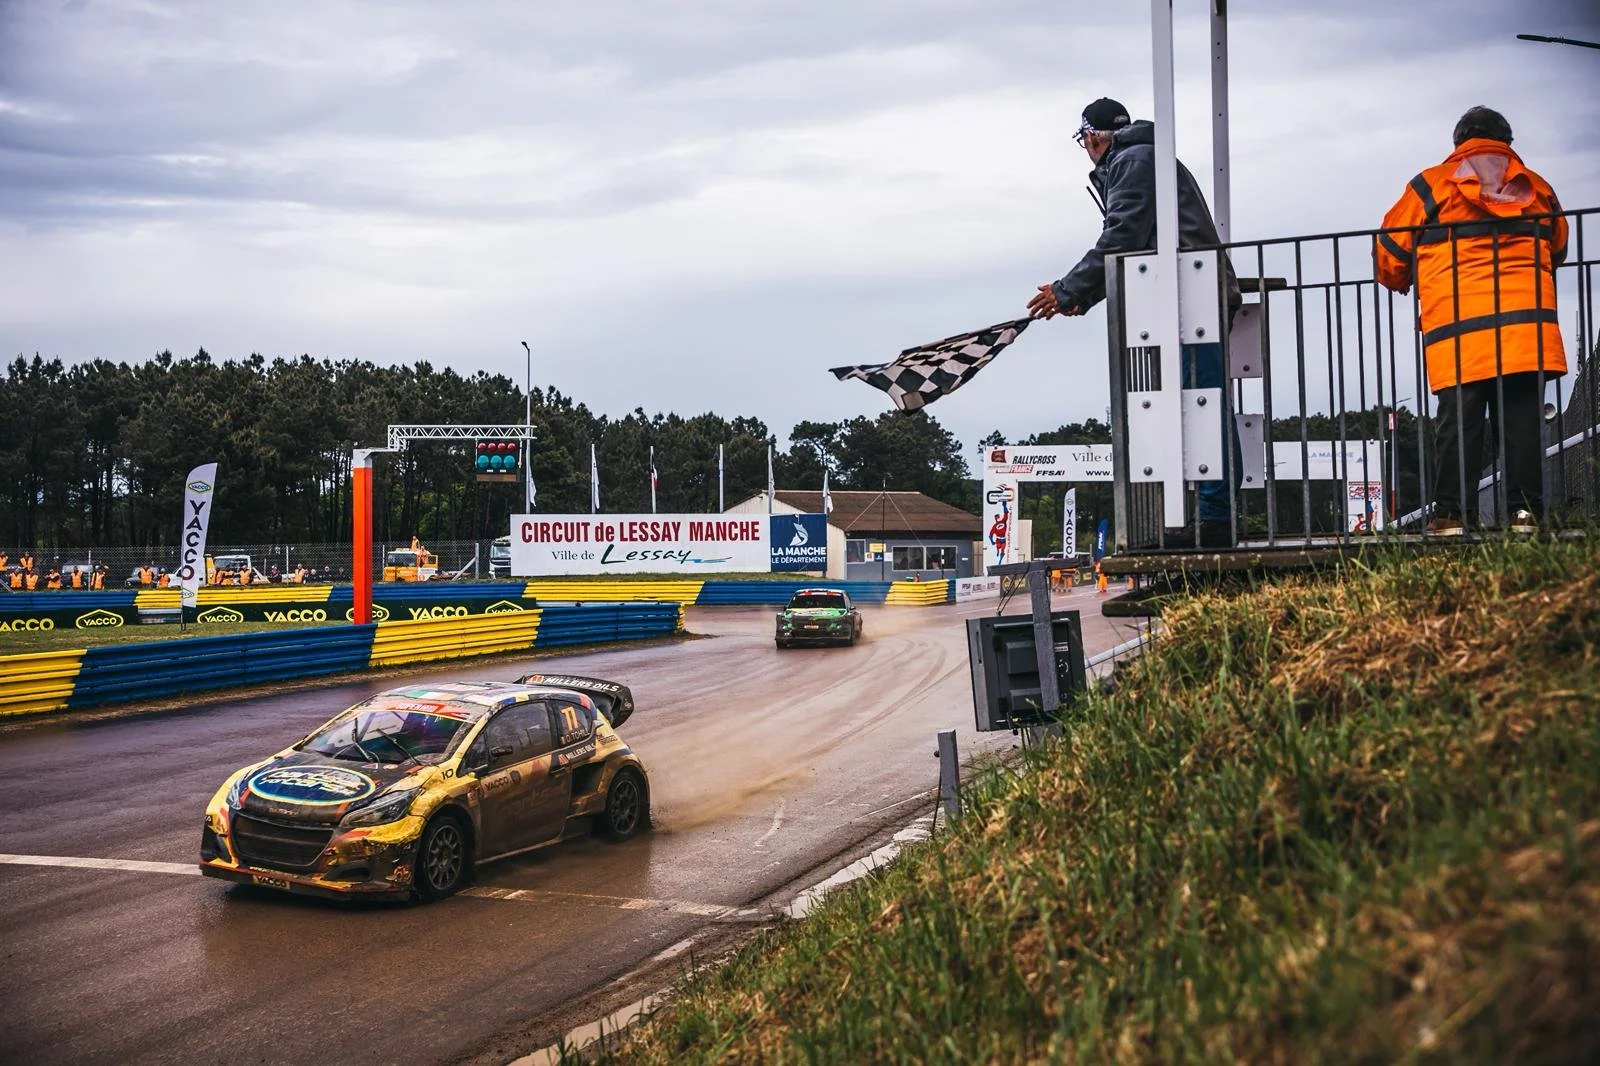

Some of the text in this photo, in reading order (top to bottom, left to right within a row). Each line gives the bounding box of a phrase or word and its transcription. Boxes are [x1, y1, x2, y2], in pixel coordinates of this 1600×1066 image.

[1012, 455, 1057, 465] RALLYCROSS
[1072, 452, 1113, 462] Ville d
[521, 521, 760, 543] CIRCUIT de LESSAY MANCHE
[1065, 509, 1074, 555] YACCO
[181, 500, 206, 581] YACCO
[552, 543, 692, 565] Ville de Lessay
[771, 546, 827, 556] LA MANCHE
[780, 556, 826, 564] DÉPARTEMENT
[204, 614, 237, 623] YACCO
[263, 609, 327, 622] YACCO
[408, 606, 468, 620] YACCO
[0, 618, 54, 632] ACCO
[84, 617, 117, 626] YACCO
[545, 677, 620, 692] MILLERS OILS
[485, 776, 509, 790] YACCO
